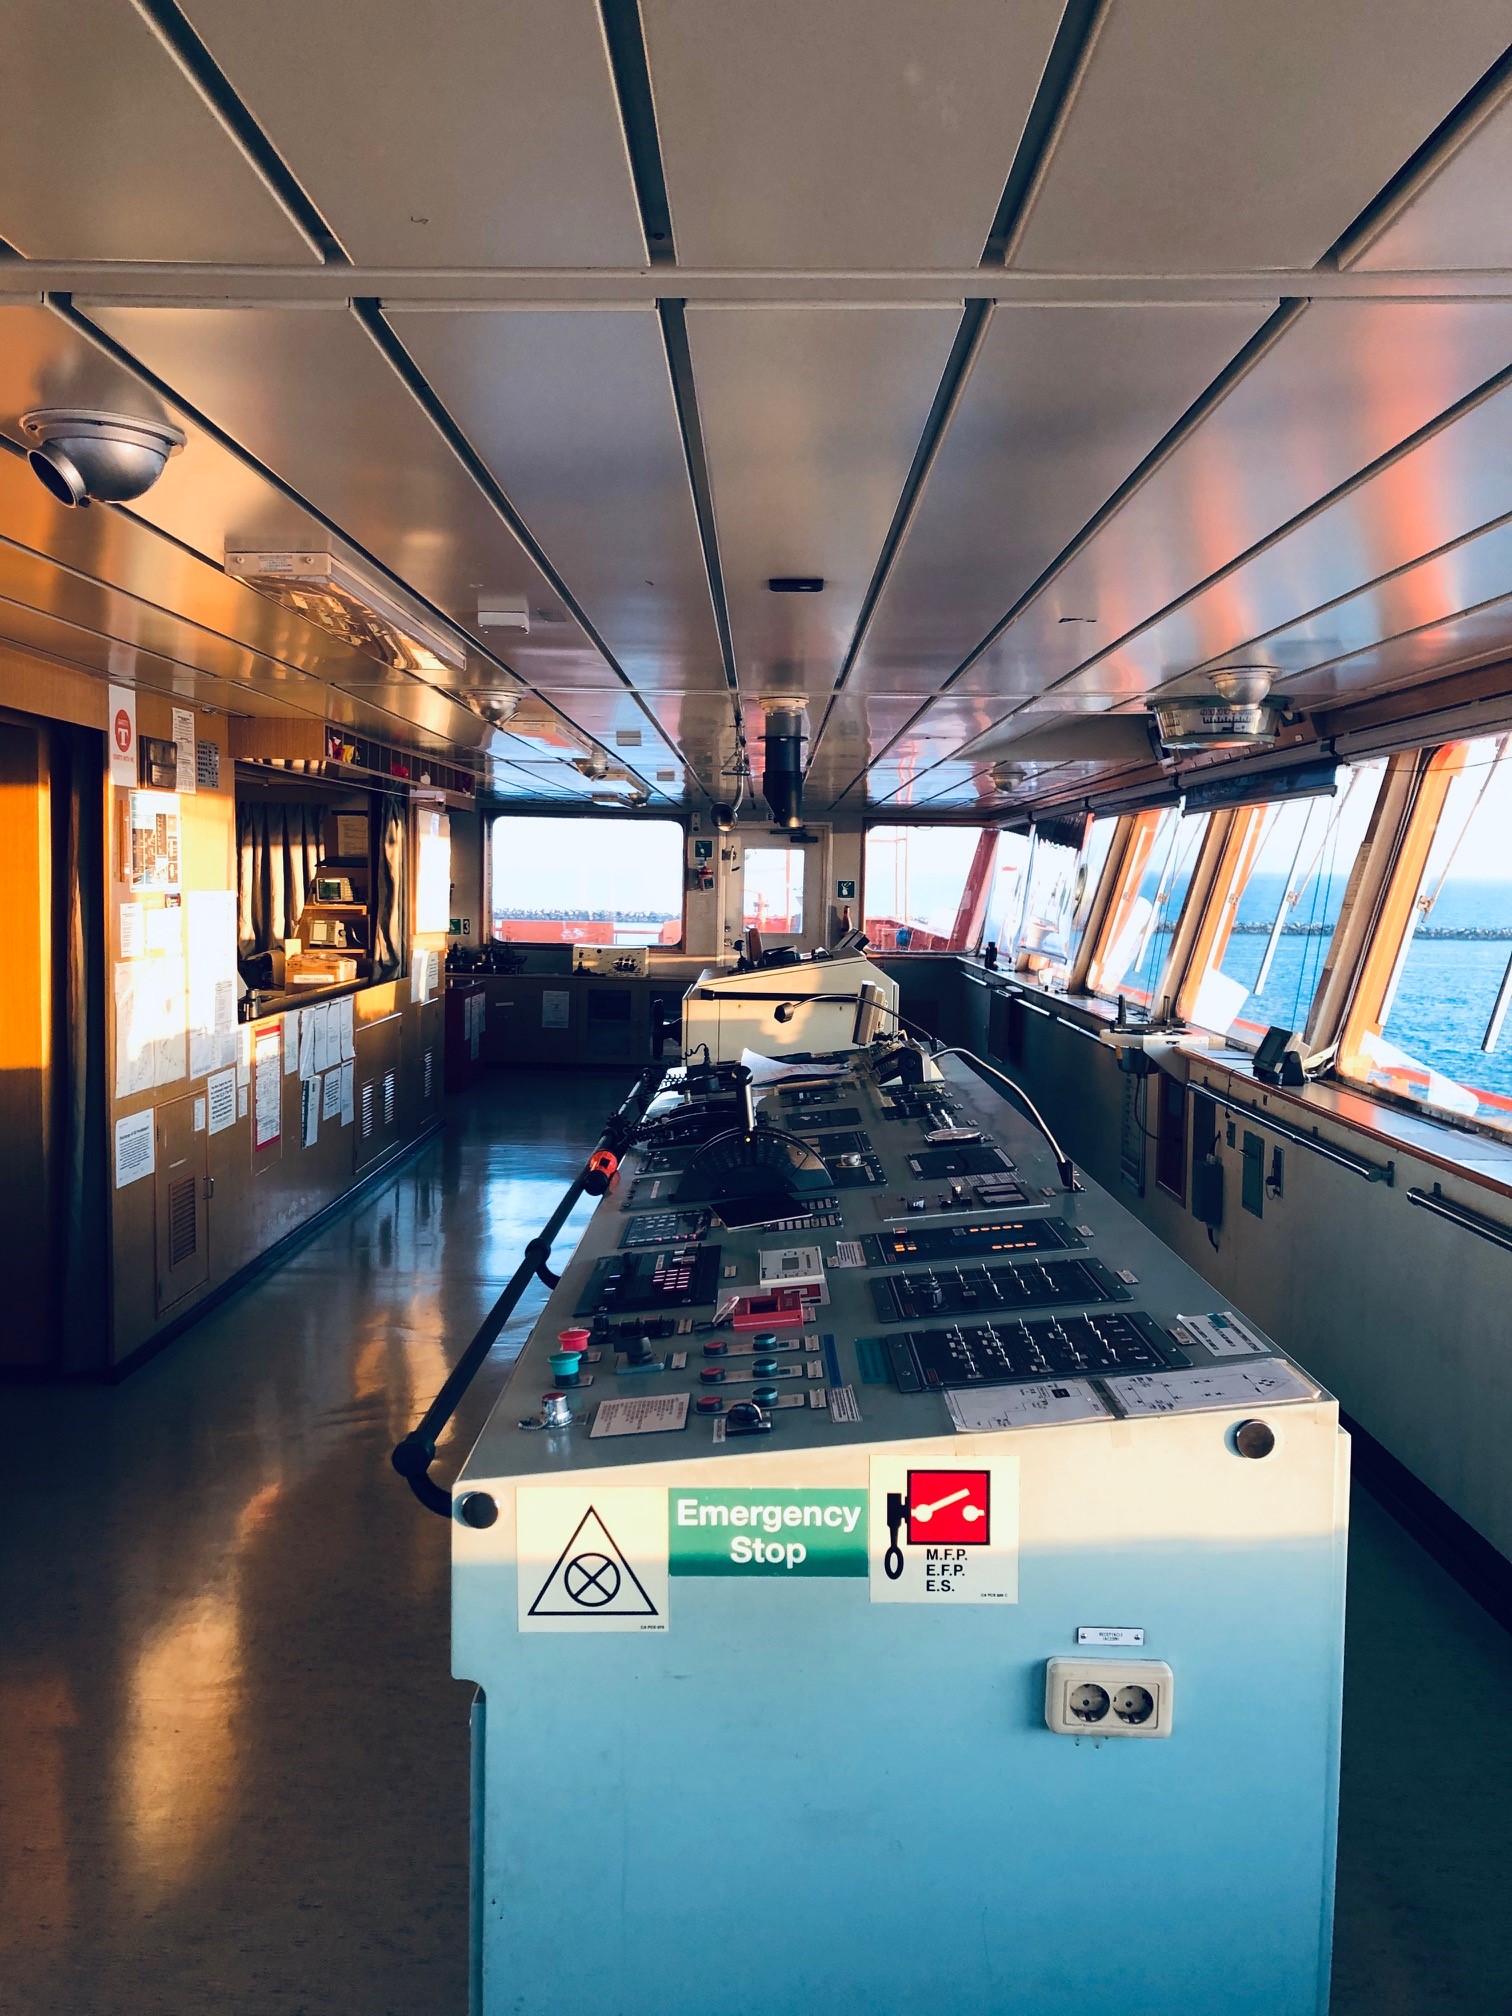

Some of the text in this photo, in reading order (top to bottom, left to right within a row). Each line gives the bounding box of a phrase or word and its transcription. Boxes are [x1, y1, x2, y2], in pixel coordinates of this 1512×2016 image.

[118, 728, 129, 746] T
[463, 920, 470, 934] 3
[677, 1498, 862, 1533] Emergency
[730, 1535, 807, 1569] Stop
[926, 1548, 968, 1561] M.F.P.
[926, 1564, 966, 1577] E.F.P.
[926, 1579, 955, 1592] E.S.
